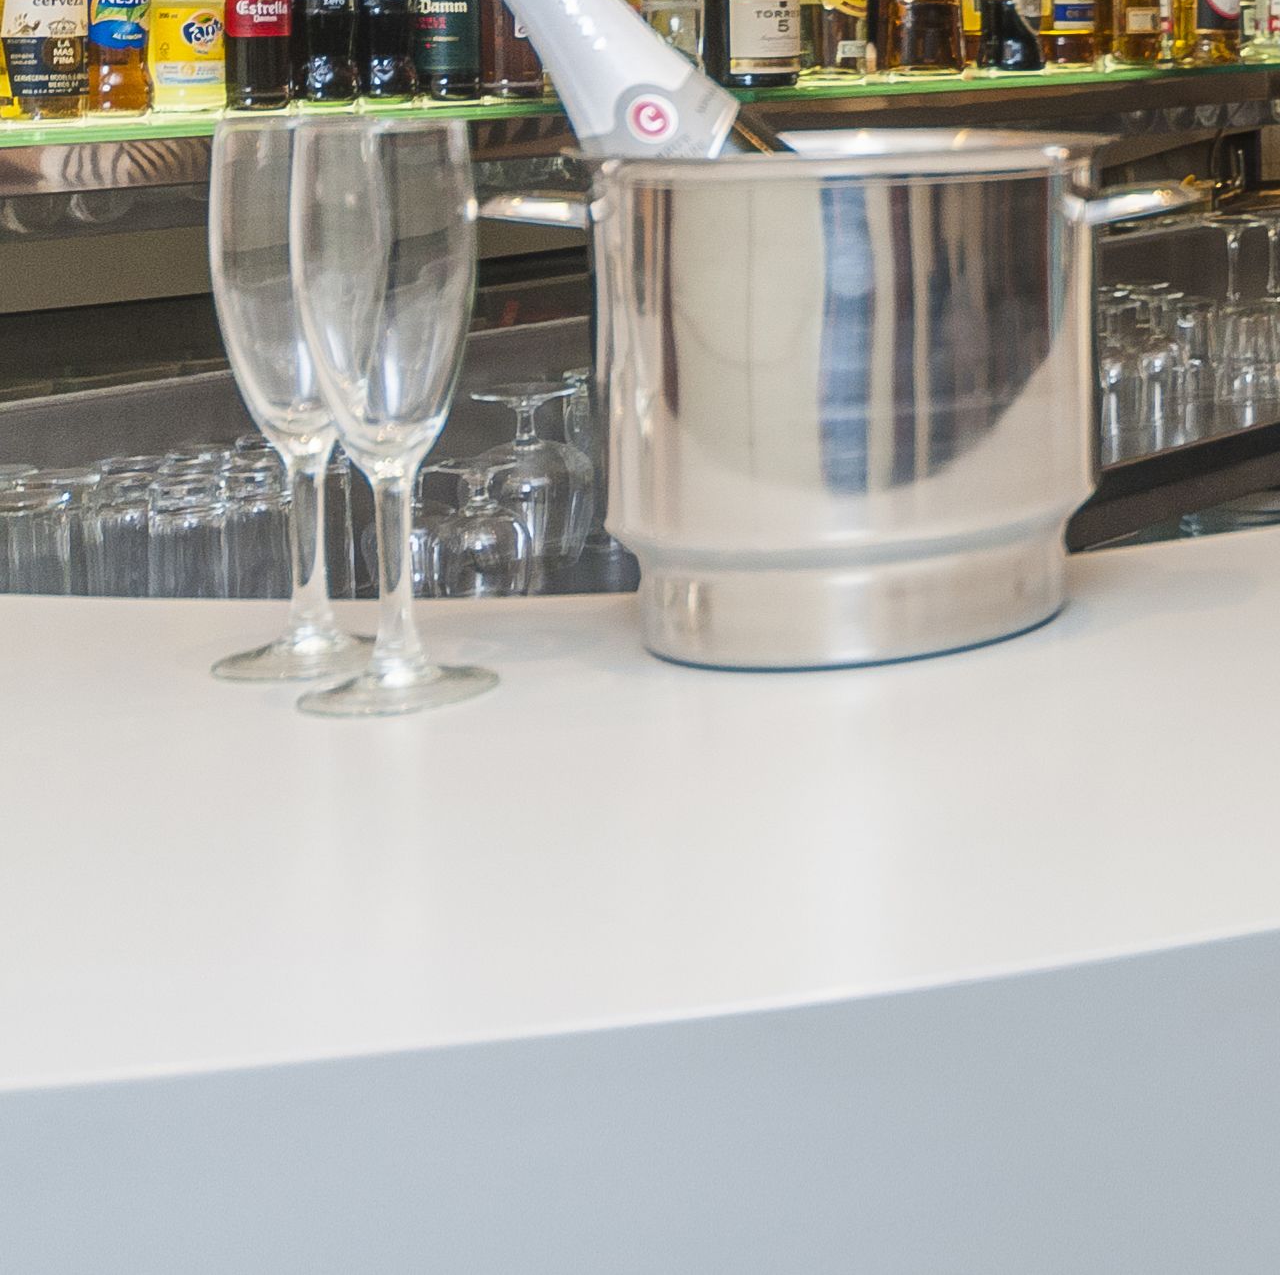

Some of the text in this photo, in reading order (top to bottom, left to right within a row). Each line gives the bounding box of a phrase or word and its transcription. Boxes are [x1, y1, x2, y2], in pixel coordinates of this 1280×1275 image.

[236, 0, 288, 15] Estrella
[778, 20, 789, 33] 5
[57, 39, 70, 47] LA
